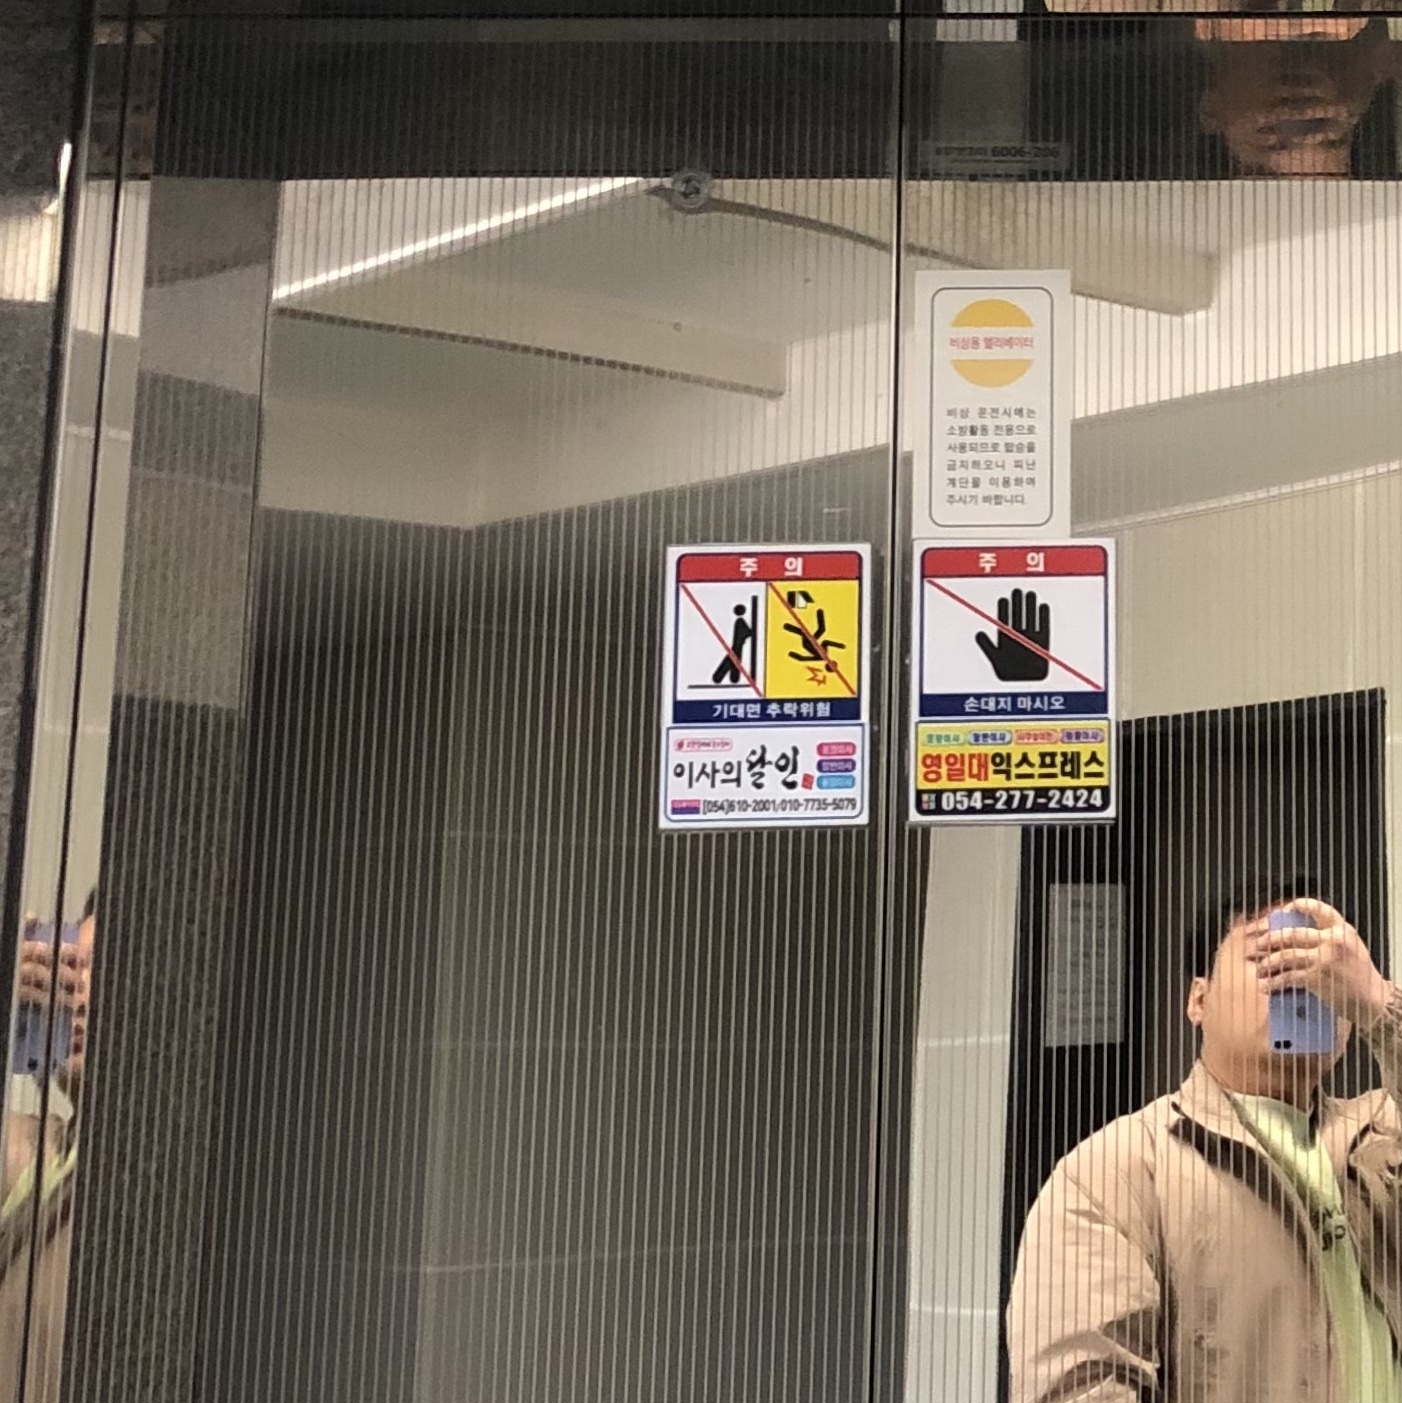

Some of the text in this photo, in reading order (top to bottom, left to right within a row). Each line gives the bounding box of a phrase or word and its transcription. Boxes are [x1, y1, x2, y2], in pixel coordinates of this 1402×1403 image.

[949, 336, 980, 350] 비상용
[946, 406, 1037, 420] 비상 운전시에는
[946, 424, 1037, 438] 소방활동 전용으로
[946, 440, 1036, 455] 사용되므로 탑승을
[946, 459, 1006, 472] 금지하오니
[989, 475, 1037, 489] 이용하며
[946, 493, 979, 507] 주시기
[712, 700, 831, 719] 기대면 추락위험
[964, 695, 1066, 713] 손대지 마시오
[922, 750, 1105, 783] 영일대익스프레스
[941, 788, 1103, 811] 054-277-2424
